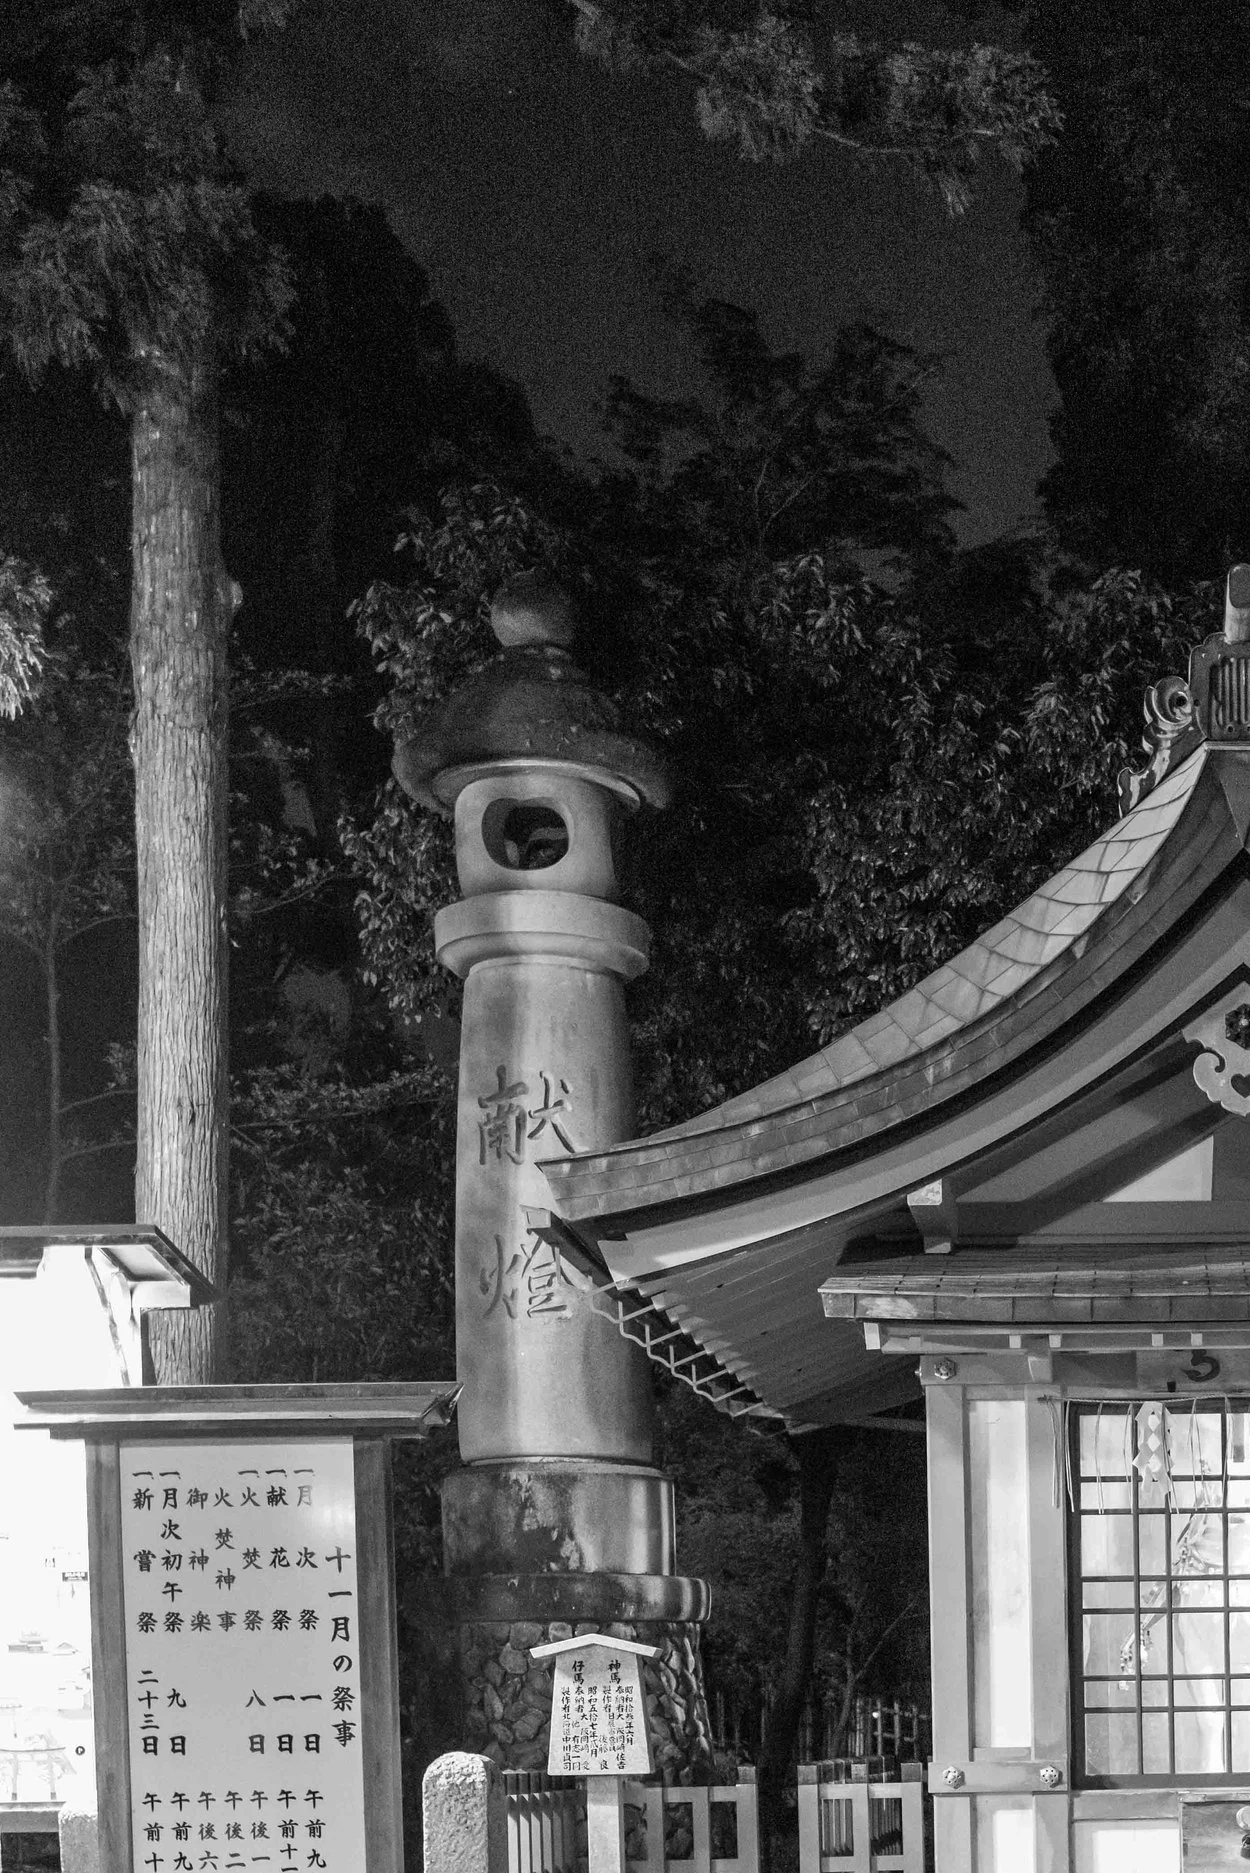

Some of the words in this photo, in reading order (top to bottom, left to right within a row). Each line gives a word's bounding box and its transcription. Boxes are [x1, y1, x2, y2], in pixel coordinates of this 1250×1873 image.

[185, 1487, 212, 1633] 御神楽
[213, 1486, 238, 1633] 火焚神事
[325, 1546, 356, 1748] 十一月の祭事
[608, 1660, 621, 1684] 神馬
[137, 1670, 160, 1756] 二十三日
[166, 1687, 187, 1756] 九日
[245, 1689, 267, 1755] 八日
[272, 1694, 296, 1755] 一日
[299, 1694, 323, 1754] 一日
